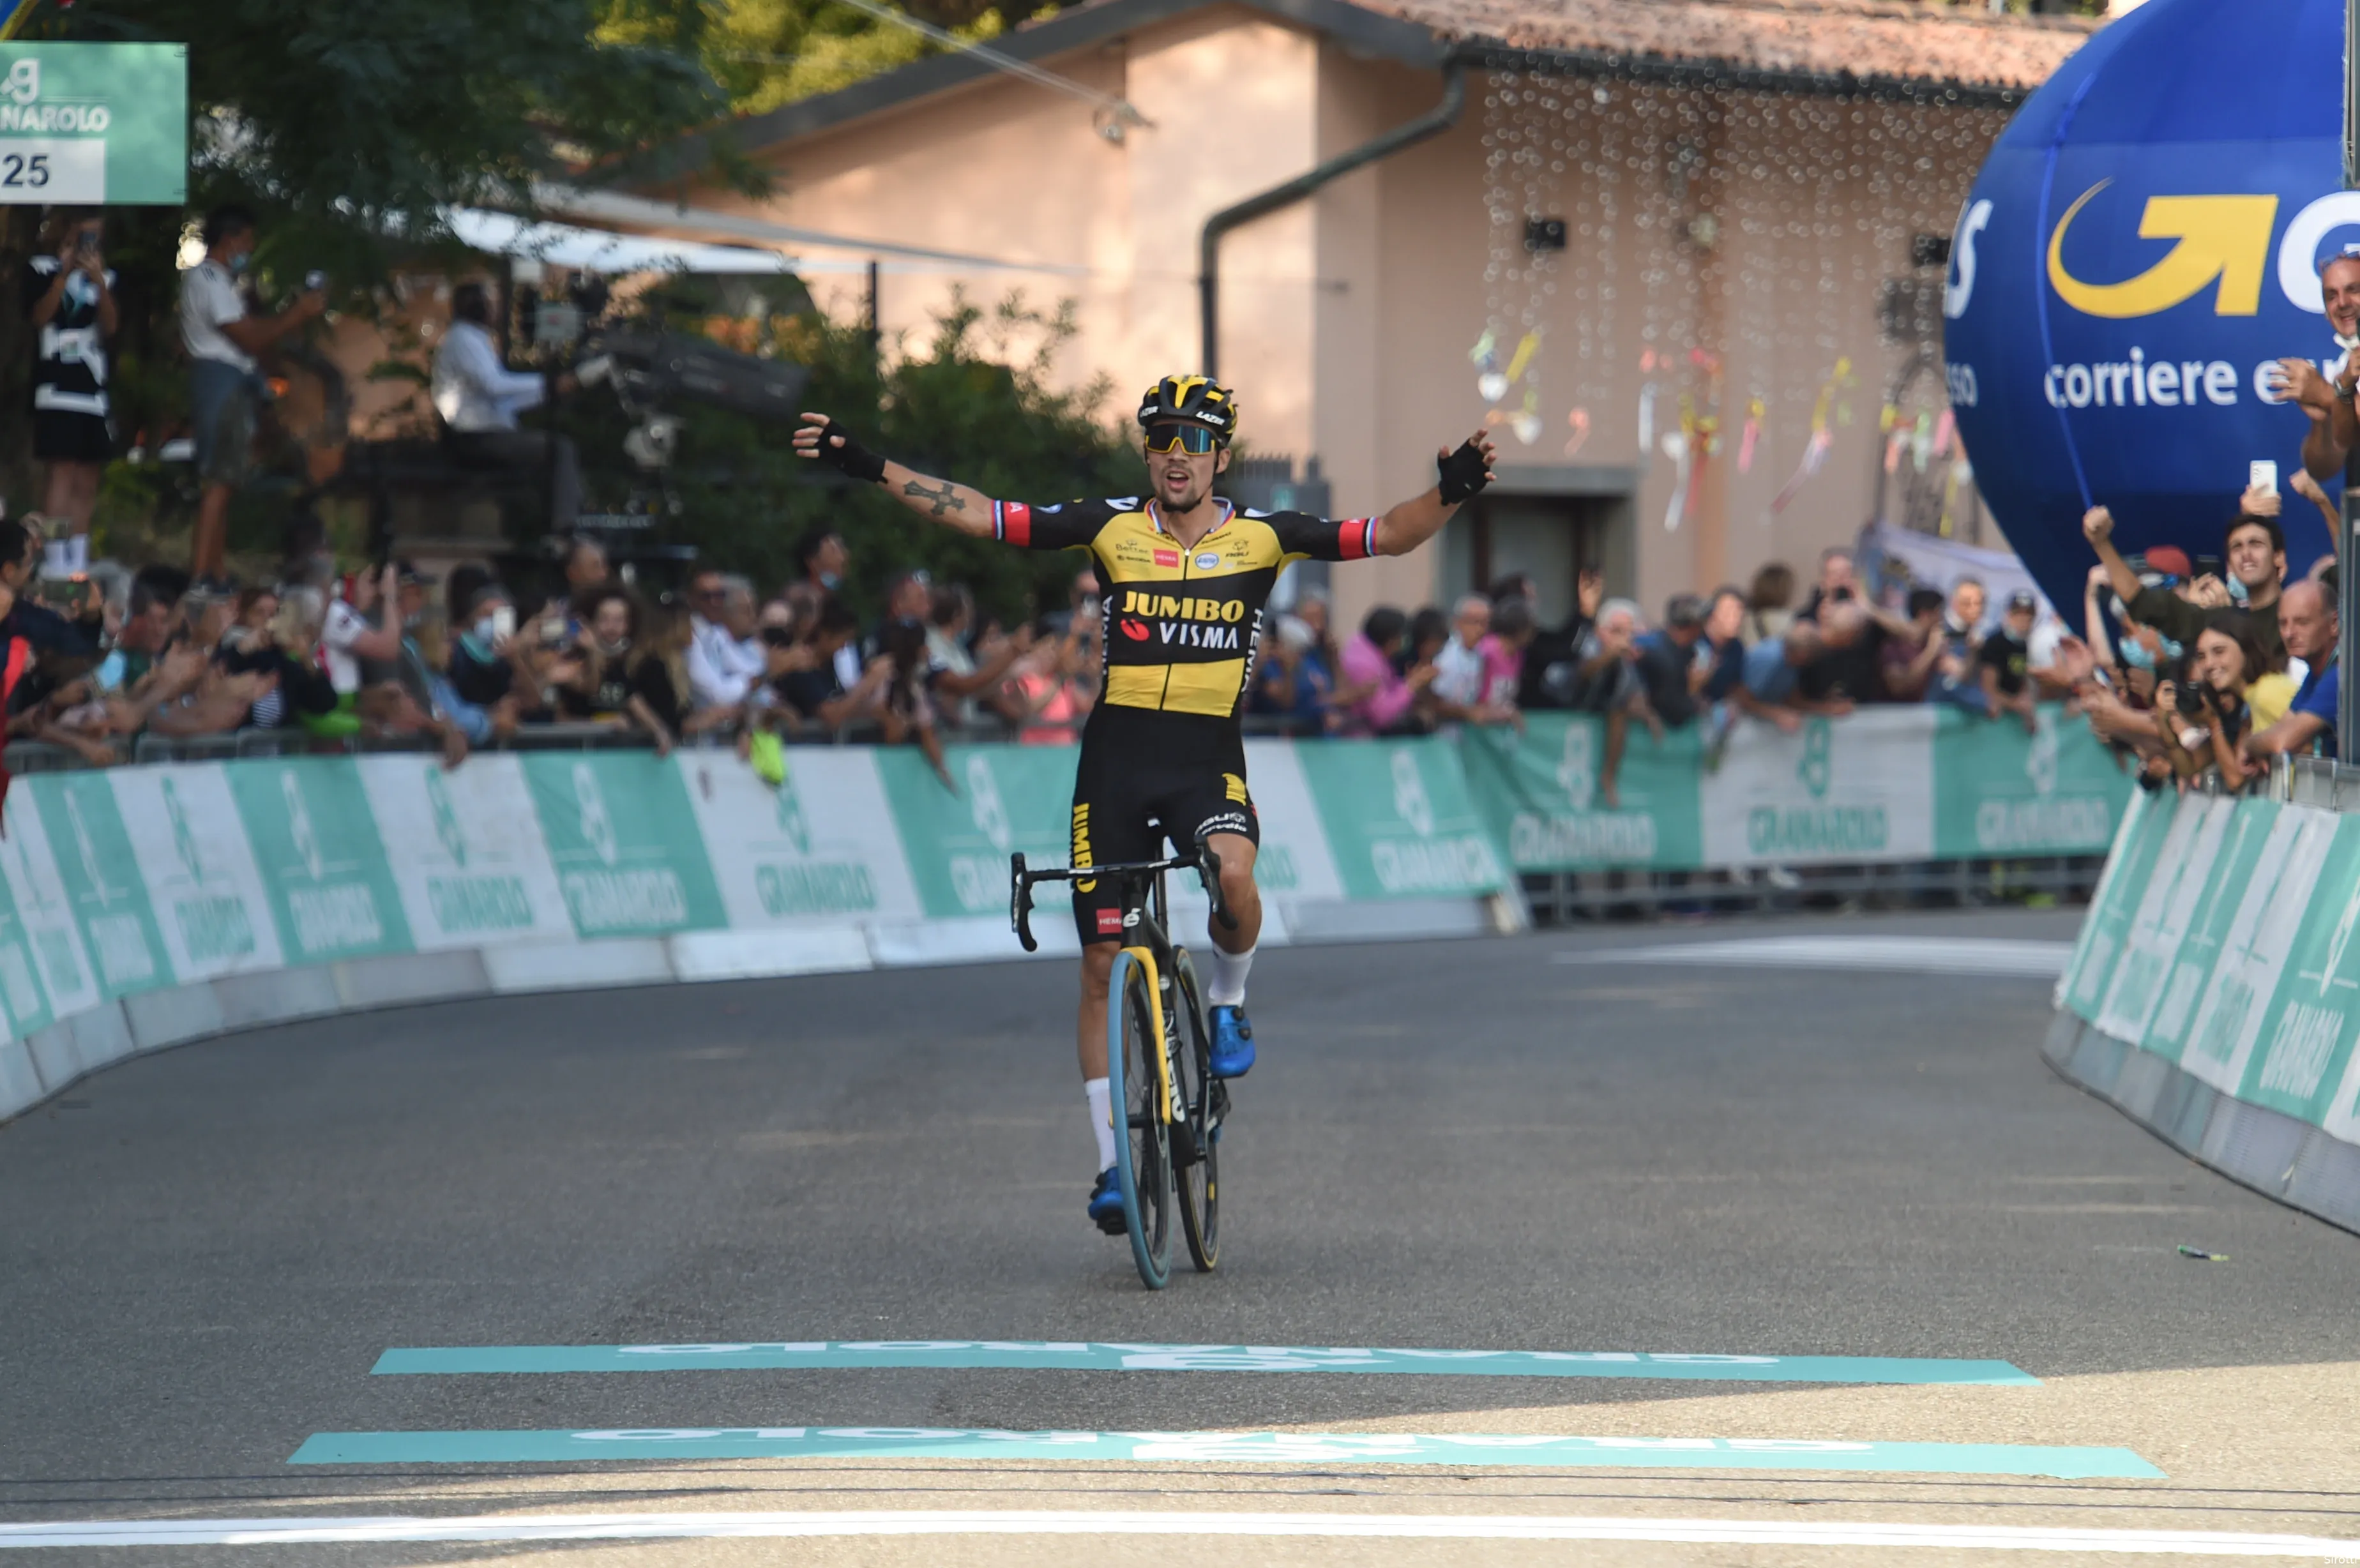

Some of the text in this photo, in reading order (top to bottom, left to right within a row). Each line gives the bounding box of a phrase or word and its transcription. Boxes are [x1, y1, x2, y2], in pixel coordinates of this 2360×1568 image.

[3, 153, 49, 187] 25
[2045, 345, 2238, 408] corriere
[1195, 411, 1225, 426] LAZER
[1121, 590, 1245, 623] JUMBO
[1159, 621, 1239, 649] VISMA
[1099, 917, 1122, 925] HEM
